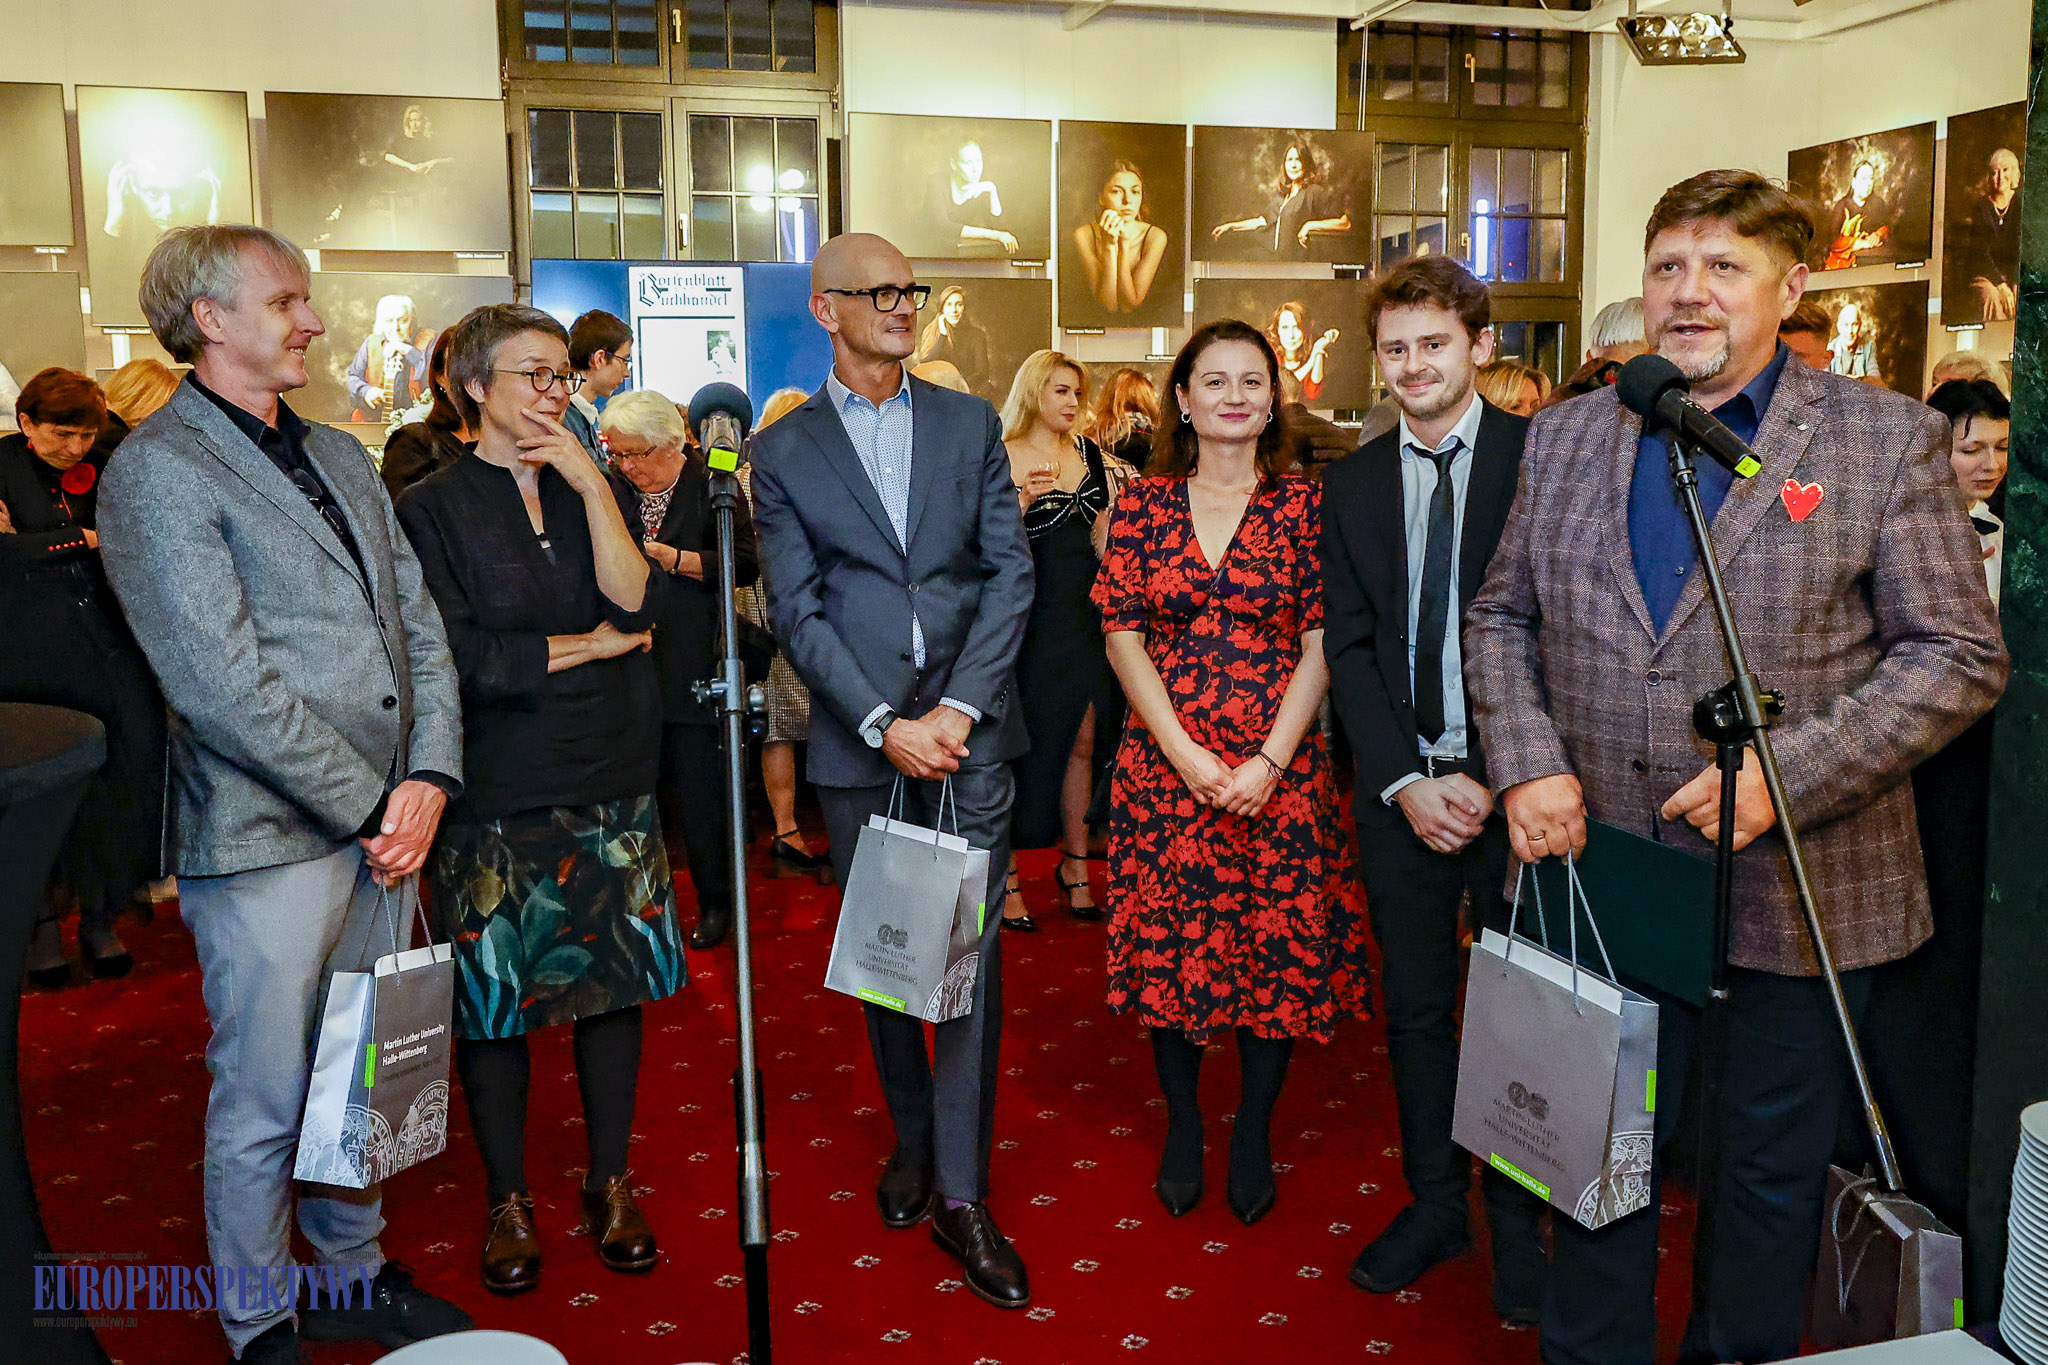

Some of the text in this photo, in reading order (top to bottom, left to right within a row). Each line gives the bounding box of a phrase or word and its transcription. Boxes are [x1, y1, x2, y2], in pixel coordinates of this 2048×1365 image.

[383, 1024, 445, 1052] Martin Luther University
[382, 1044, 428, 1067] Halle-Wittenberg
[1494, 1159, 1546, 1195] www.uni-halle.de
